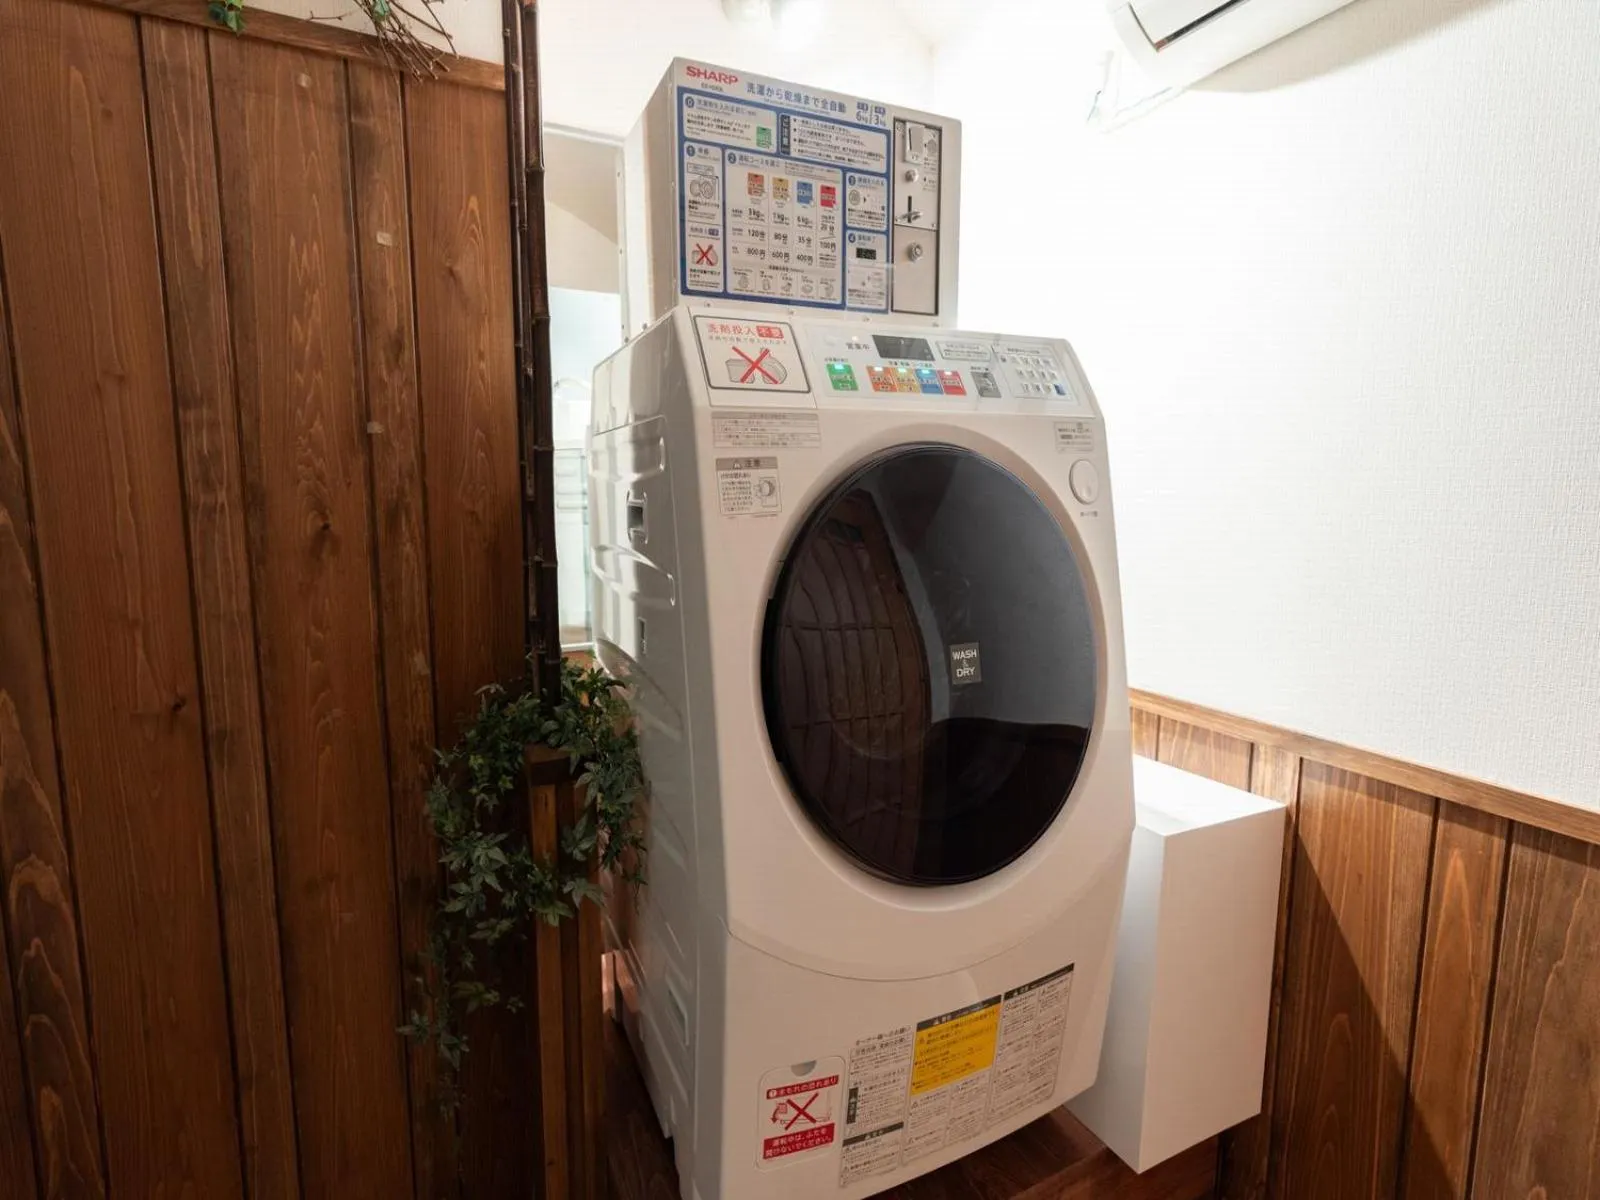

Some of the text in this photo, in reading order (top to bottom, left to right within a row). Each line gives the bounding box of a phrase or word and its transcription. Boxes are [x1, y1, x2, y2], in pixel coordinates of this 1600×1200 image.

[686, 66, 738, 85] SHARP
[746, 82, 846, 113] 洗濯から乾燥まで全自動
[952, 649, 977, 660] WASH
[956, 667, 976, 677] DRY
